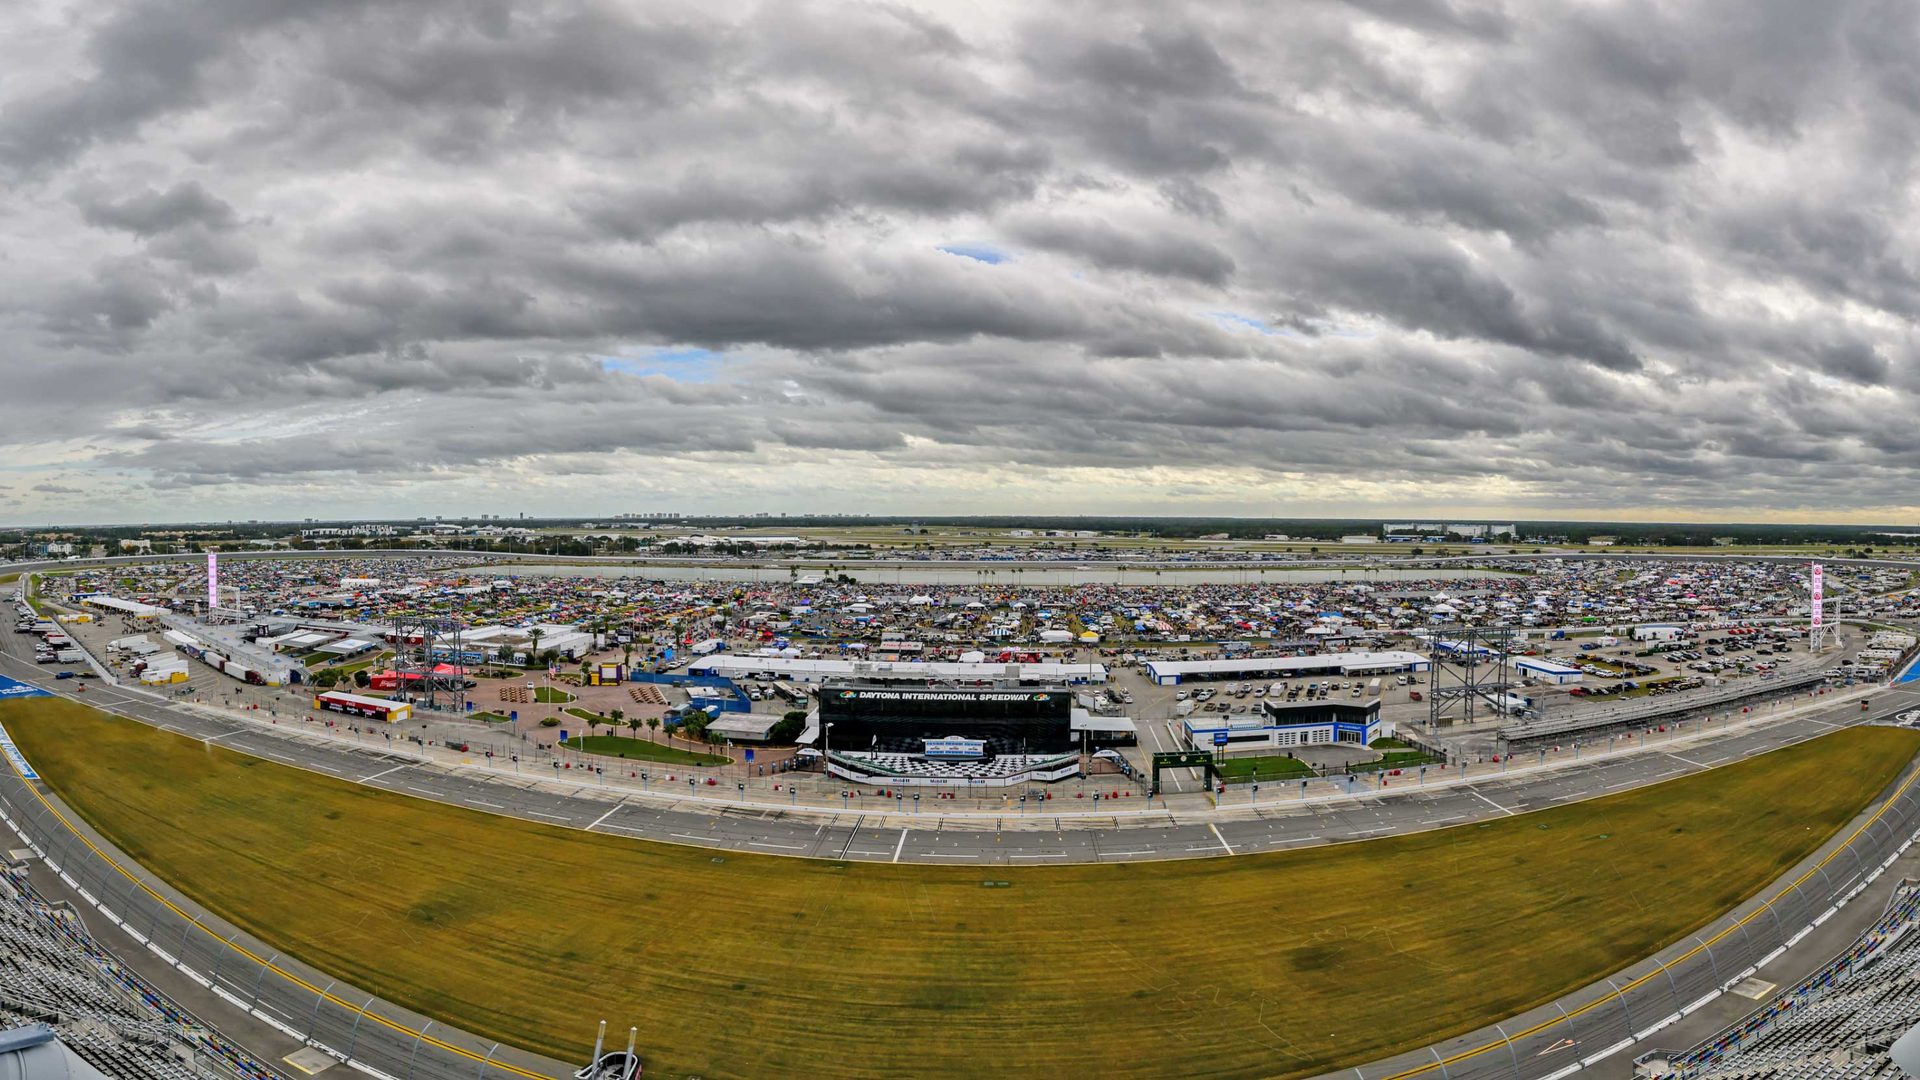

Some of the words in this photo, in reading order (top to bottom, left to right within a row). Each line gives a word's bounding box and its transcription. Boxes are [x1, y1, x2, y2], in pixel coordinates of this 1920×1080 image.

[859, 691, 900, 699] DAYTONA
[902, 692, 977, 701] INTERNATIONAL
[979, 693, 1031, 701] SPEEDWAY
